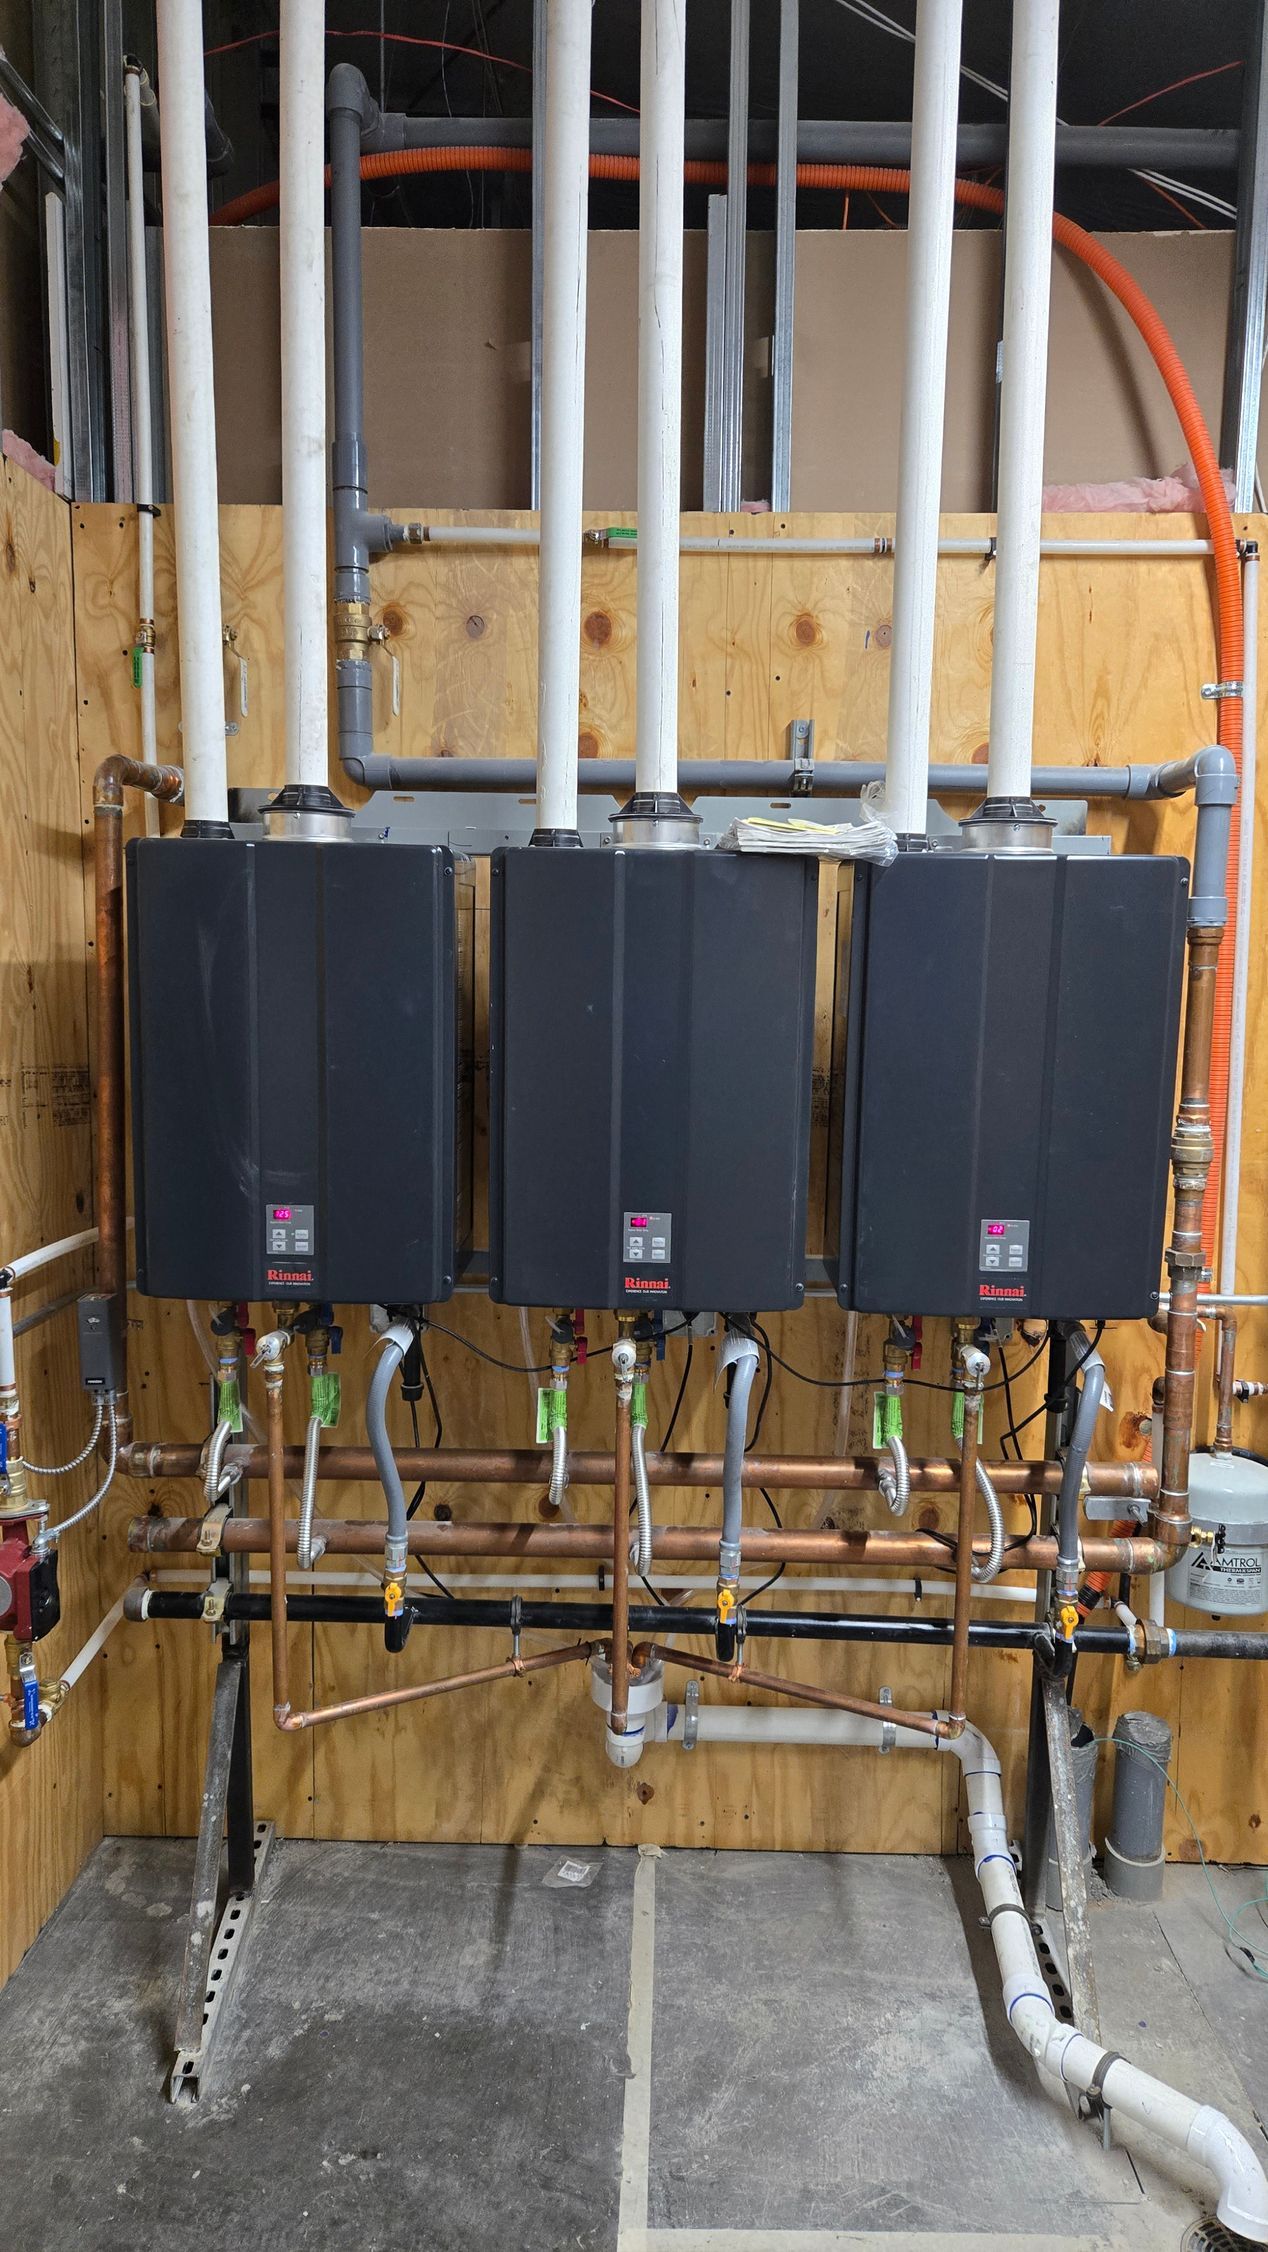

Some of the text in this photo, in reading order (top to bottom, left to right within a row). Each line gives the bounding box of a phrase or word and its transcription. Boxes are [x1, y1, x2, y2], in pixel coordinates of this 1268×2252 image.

[275, 1210, 289, 1218] 125
[267, 1269, 313, 1281] Rinnai
[624, 1277, 669, 1289] Rinnai
[979, 1284, 1025, 1297] Rinnai
